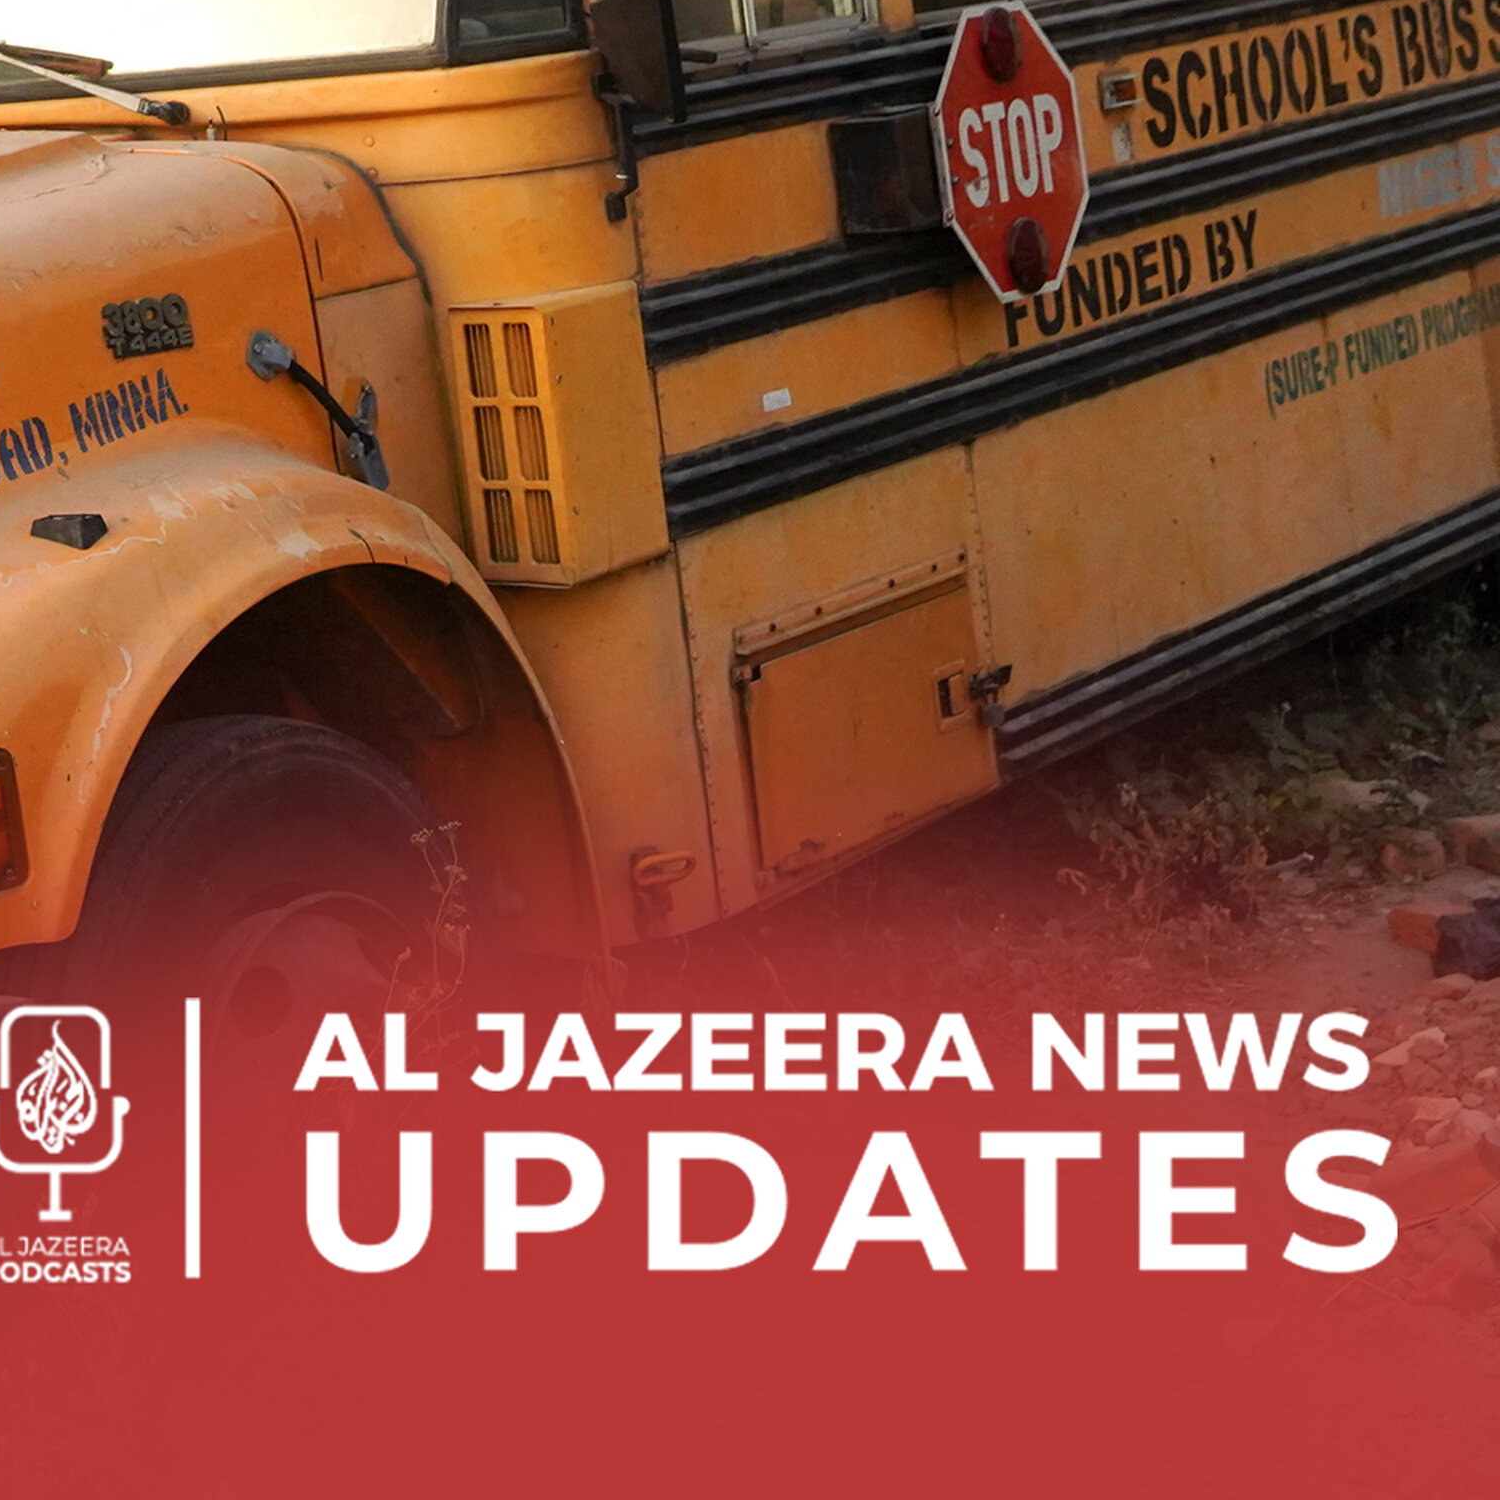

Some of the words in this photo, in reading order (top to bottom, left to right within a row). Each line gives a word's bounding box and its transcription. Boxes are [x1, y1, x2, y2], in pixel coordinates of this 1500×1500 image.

[1141, 13, 1383, 148] SCHOOL'S
[958, 94, 1063, 208] STOP
[101, 293, 188, 338] 3800
[1003, 233, 1192, 348] FUNDED
[1205, 210, 1258, 283] BY
[1344, 314, 1420, 380] FUNDED
